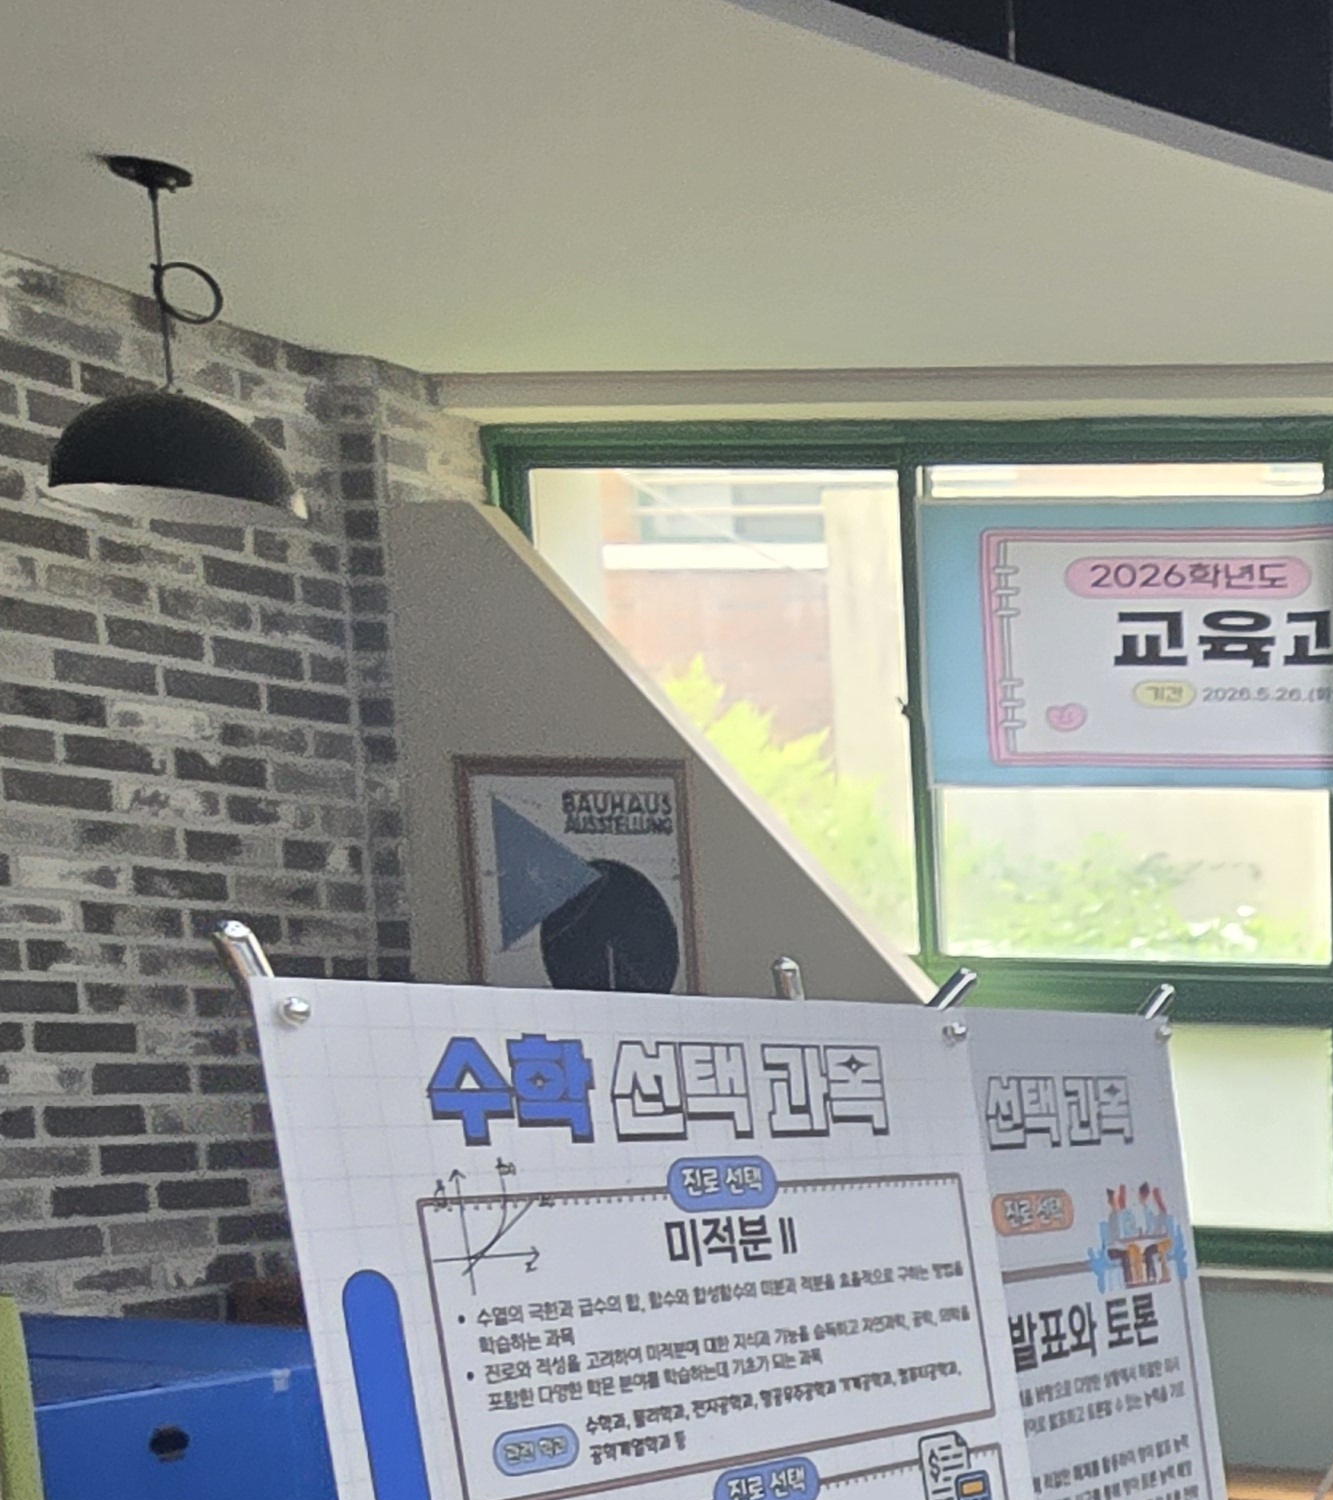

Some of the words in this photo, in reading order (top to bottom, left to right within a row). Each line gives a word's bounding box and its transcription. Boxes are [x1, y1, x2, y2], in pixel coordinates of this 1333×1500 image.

[1090, 563, 1289, 590] 2026학년도
[561, 790, 673, 816] BAUHAUS
[427, 1033, 595, 1146] 수학
[611, 1039, 754, 1142] 선택
[760, 1042, 890, 1139] 과목
[985, 1075, 1063, 1152] 선택
[1062, 1075, 1135, 1149] 과목
[681, 1165, 721, 1196] 진로
[724, 1163, 764, 1194] 선택
[664, 1215, 773, 1267] 미적분
[477, 1305, 524, 1327] 수열의
[529, 1300, 574, 1321] 극한과
[578, 1295, 622, 1318] 급수의
[648, 1288, 690, 1310] 함수와
[479, 1333, 542, 1355] 학습하는
[544, 1327, 576, 1348] 과목
[1007, 1301, 1098, 1374] 발표와
[1105, 1292, 1161, 1350] 토론
[485, 1360, 533, 1385] 진로와
[536, 1353, 582, 1376] 적성을
[586, 1347, 643, 1371] 고려하여
[646, 1339, 701, 1363] 미적분에
[703, 1336, 730, 1354] 대한
[733, 1330, 771, 1351] 지식과
[488, 1388, 534, 1413] 포함한
[537, 1381, 583, 1405] 다양한
[619, 1370, 661, 1394] 분야를
[732, 1355, 770, 1375] 기초가
[771, 1352, 797, 1370] 되는
[799, 1347, 824, 1366] 과목
[769, 1466, 807, 1498] 선택
